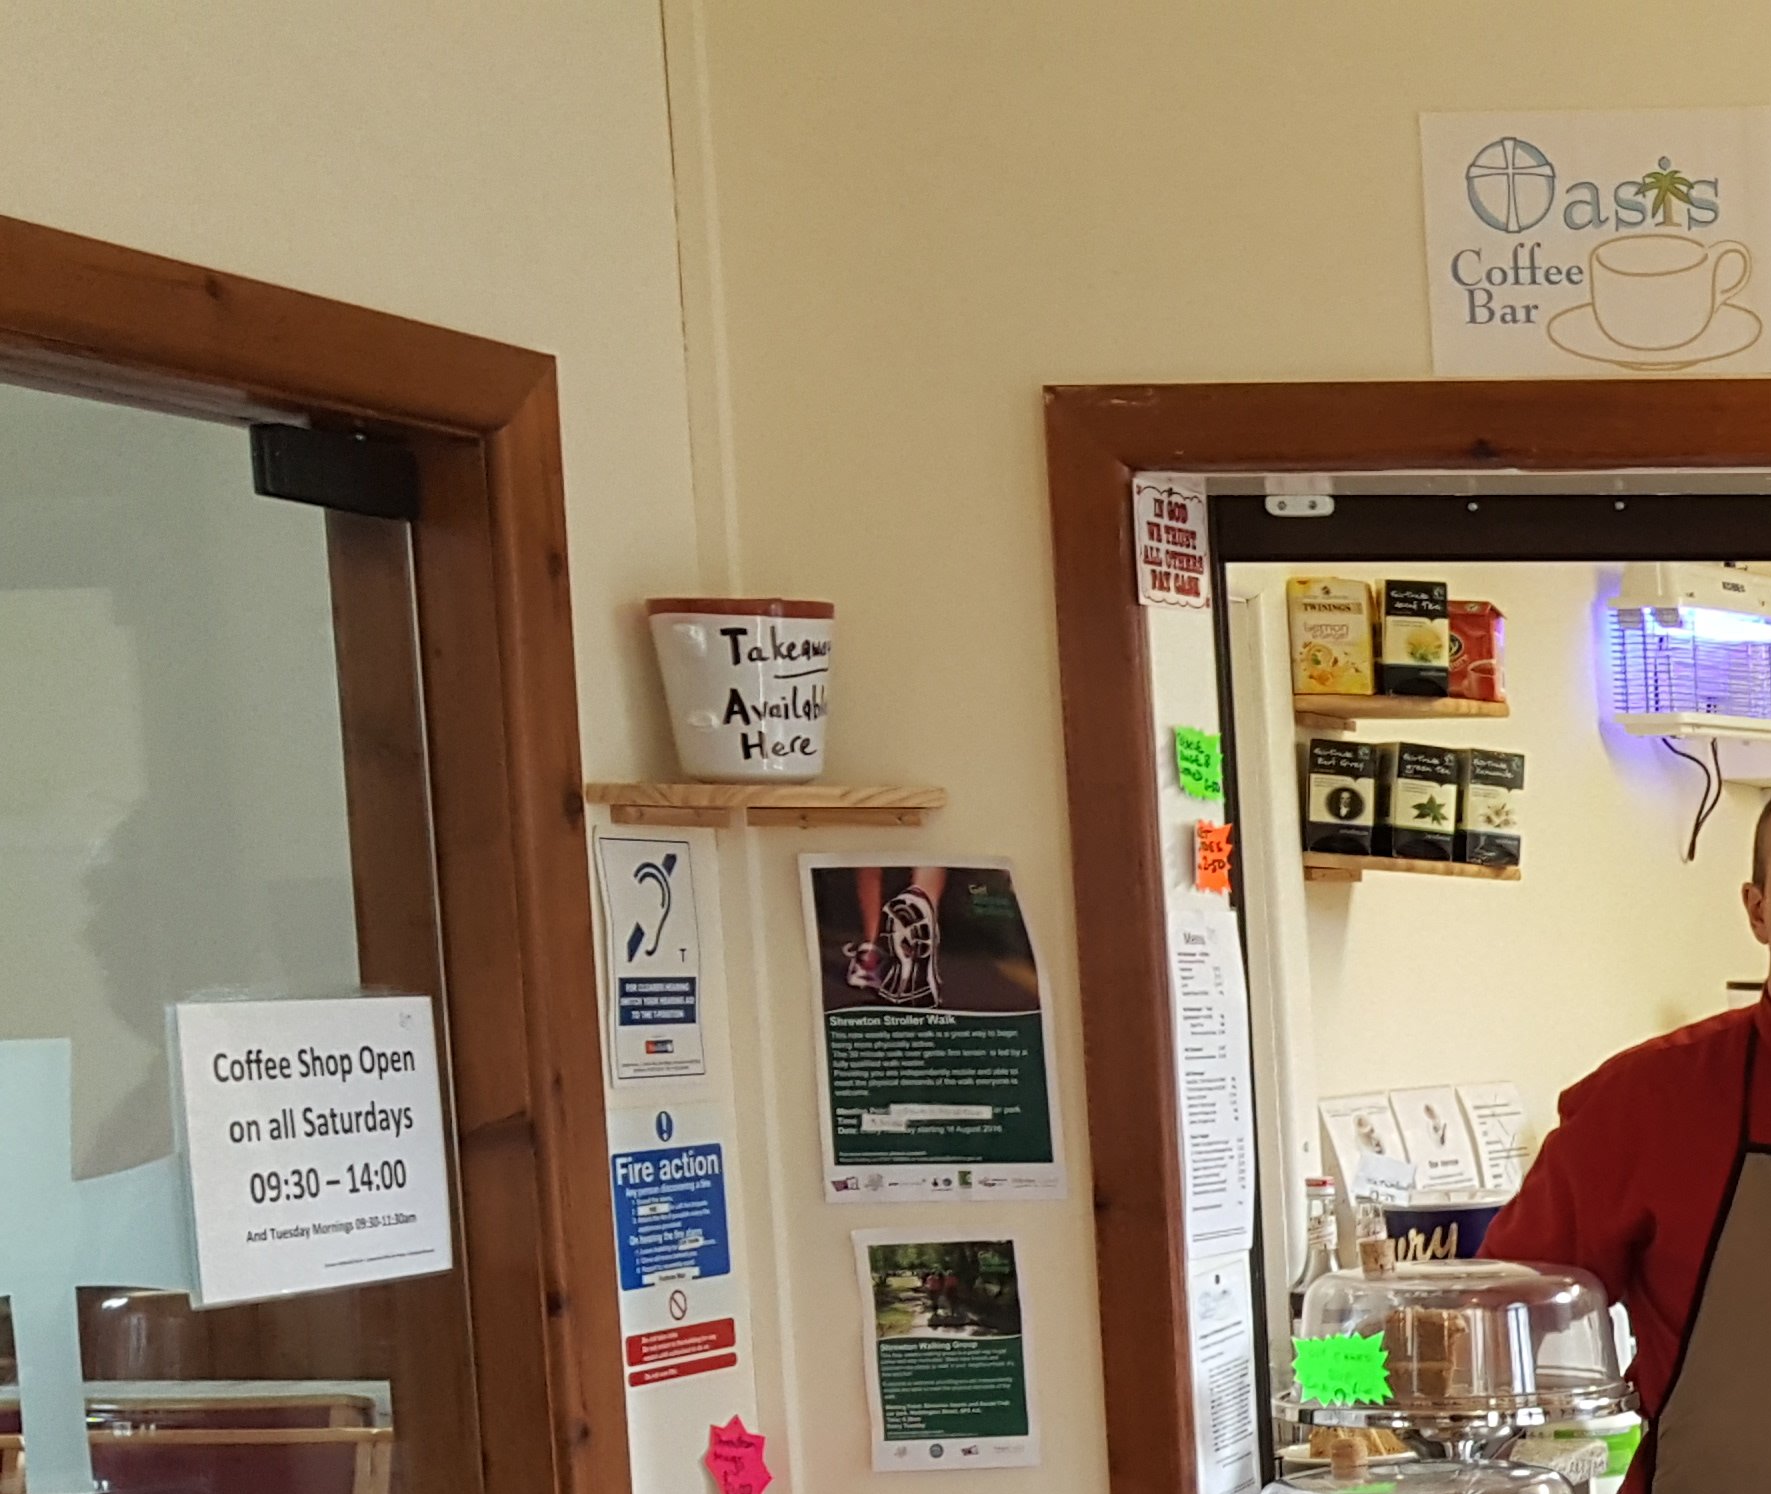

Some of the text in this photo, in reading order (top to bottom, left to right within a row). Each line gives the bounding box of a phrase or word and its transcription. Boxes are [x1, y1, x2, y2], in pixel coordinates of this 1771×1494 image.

[1451, 242, 1584, 288] Coffee
[1465, 288, 1539, 326] Bar
[1303, 603, 1352, 612] TWININGS
[723, 685, 828, 726] Availabl
[741, 731, 817, 760] Here
[830, 1015, 956, 1027] Shrewton Stroller Walk
[213, 1046, 415, 1083] Coffee Shop Open
[229, 1101, 413, 1143] on all Saturdays
[250, 1159, 407, 1203] 09:30 14:00
[616, 1150, 720, 1185] Fire action
[247, 1228, 267, 1243] And
[269, 1224, 310, 1241] Tuesday
[312, 1217, 353, 1236] Mornings
